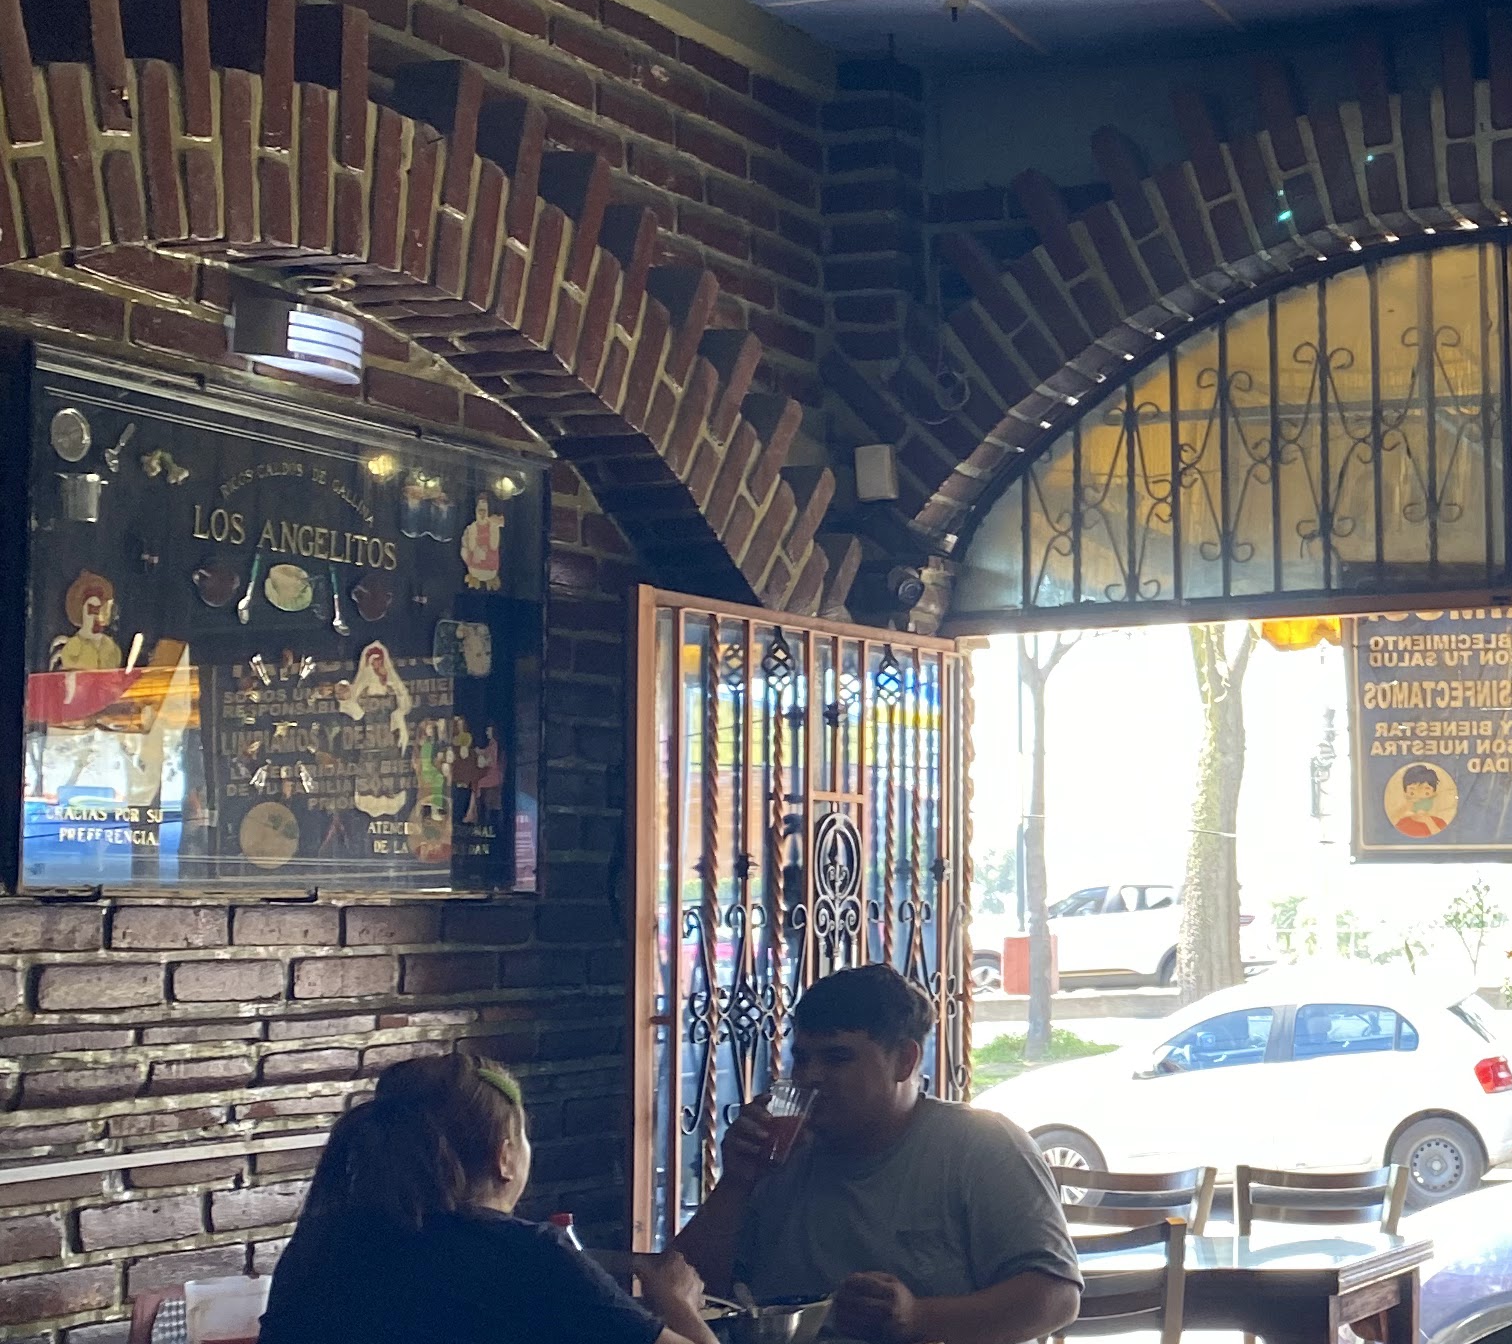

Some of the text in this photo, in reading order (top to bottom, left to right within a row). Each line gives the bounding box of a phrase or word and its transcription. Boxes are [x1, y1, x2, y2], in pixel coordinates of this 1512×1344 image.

[193, 504, 398, 571] LOS ANGELITOS
[114, 807, 140, 823] POR
[146, 808, 164, 823] SU
[373, 839, 388, 854] DE
[393, 840, 409, 854] LA
